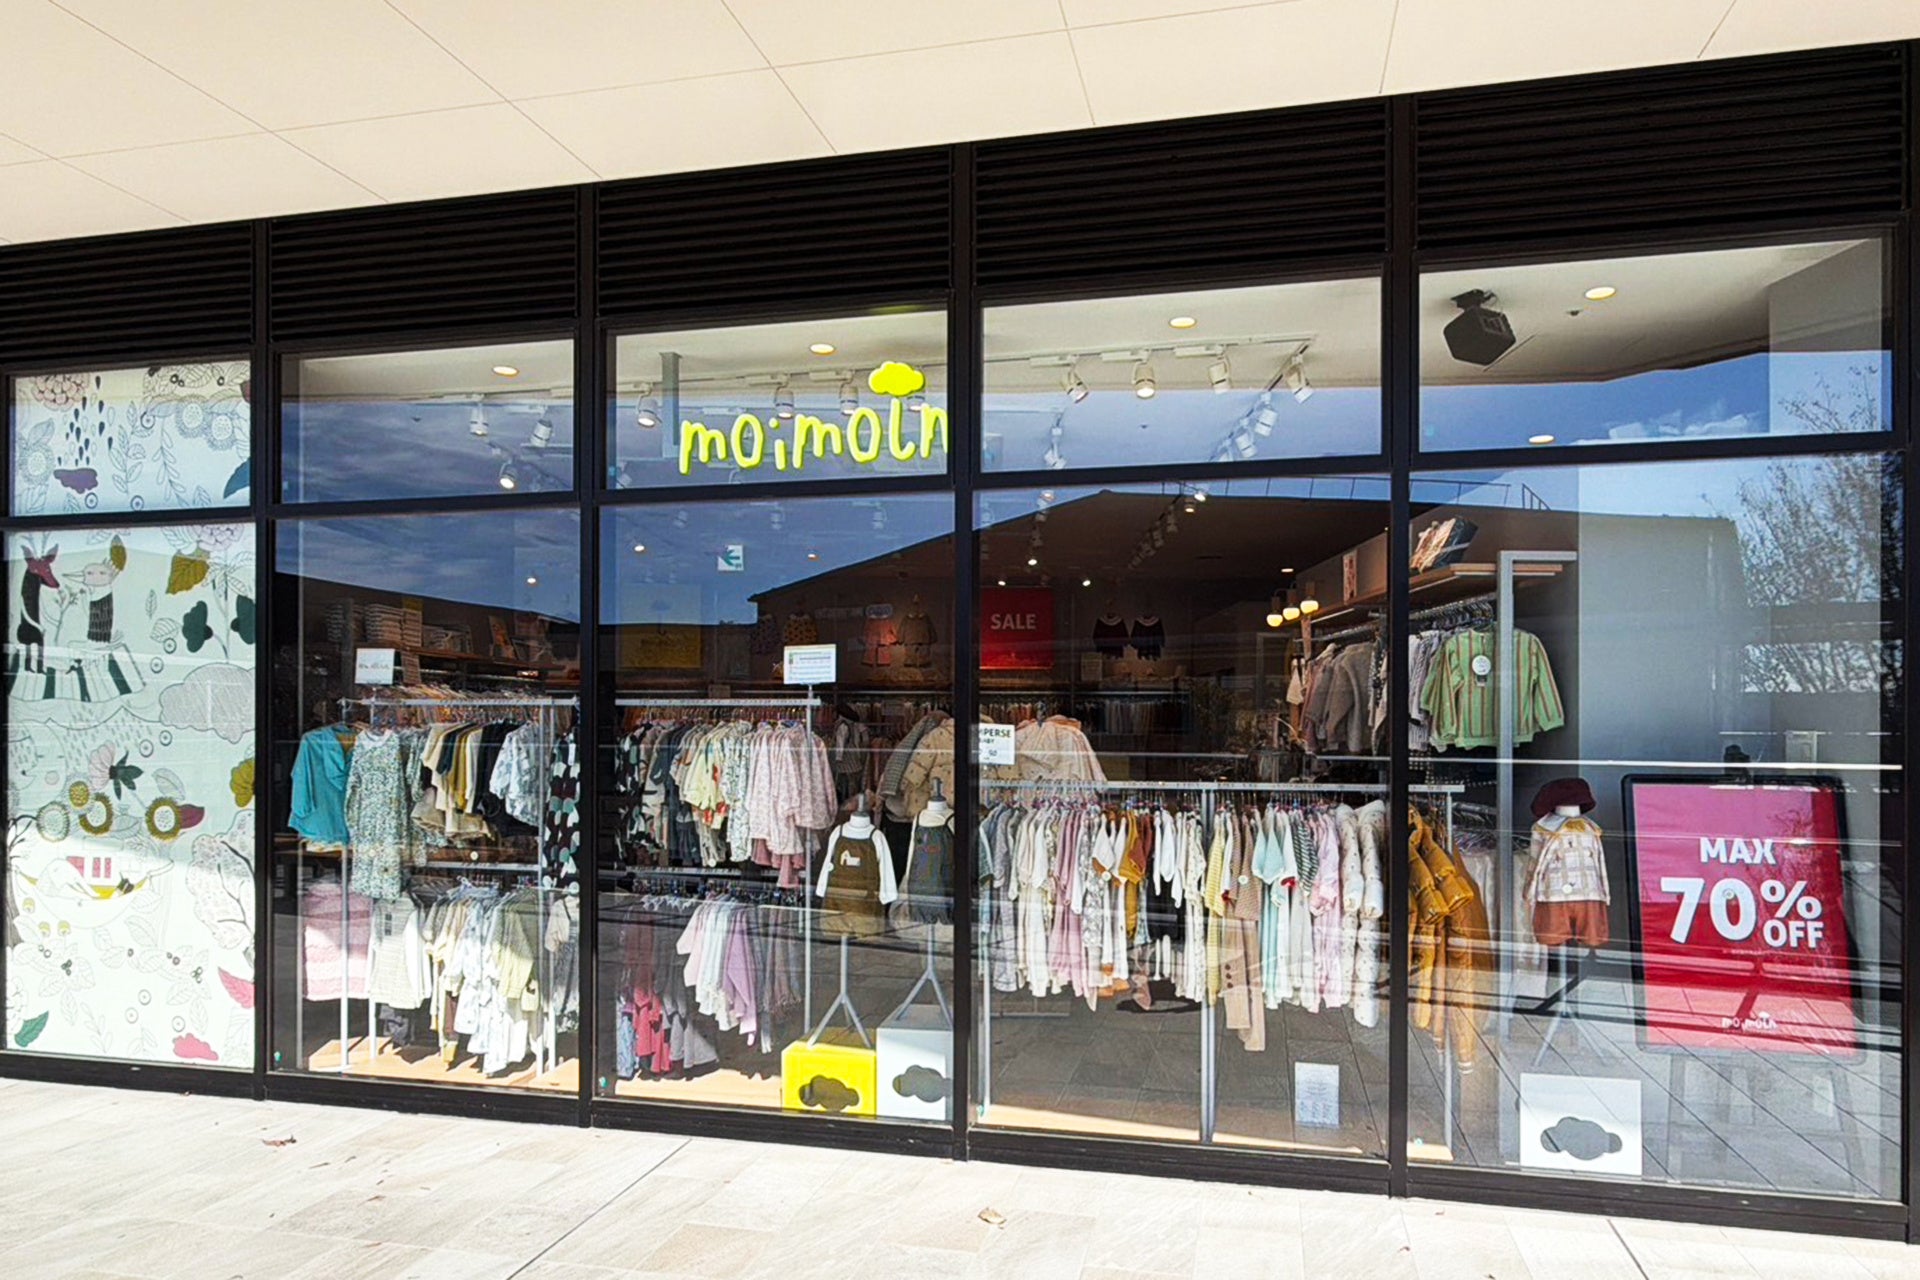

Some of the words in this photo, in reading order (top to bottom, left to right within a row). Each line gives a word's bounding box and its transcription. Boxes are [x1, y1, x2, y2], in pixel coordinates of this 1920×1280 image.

[990, 613, 1037, 630] SALE
[1700, 837, 1776, 865] MAX
[1660, 876, 1823, 944] 70%
[1762, 919, 1824, 949] OFF
